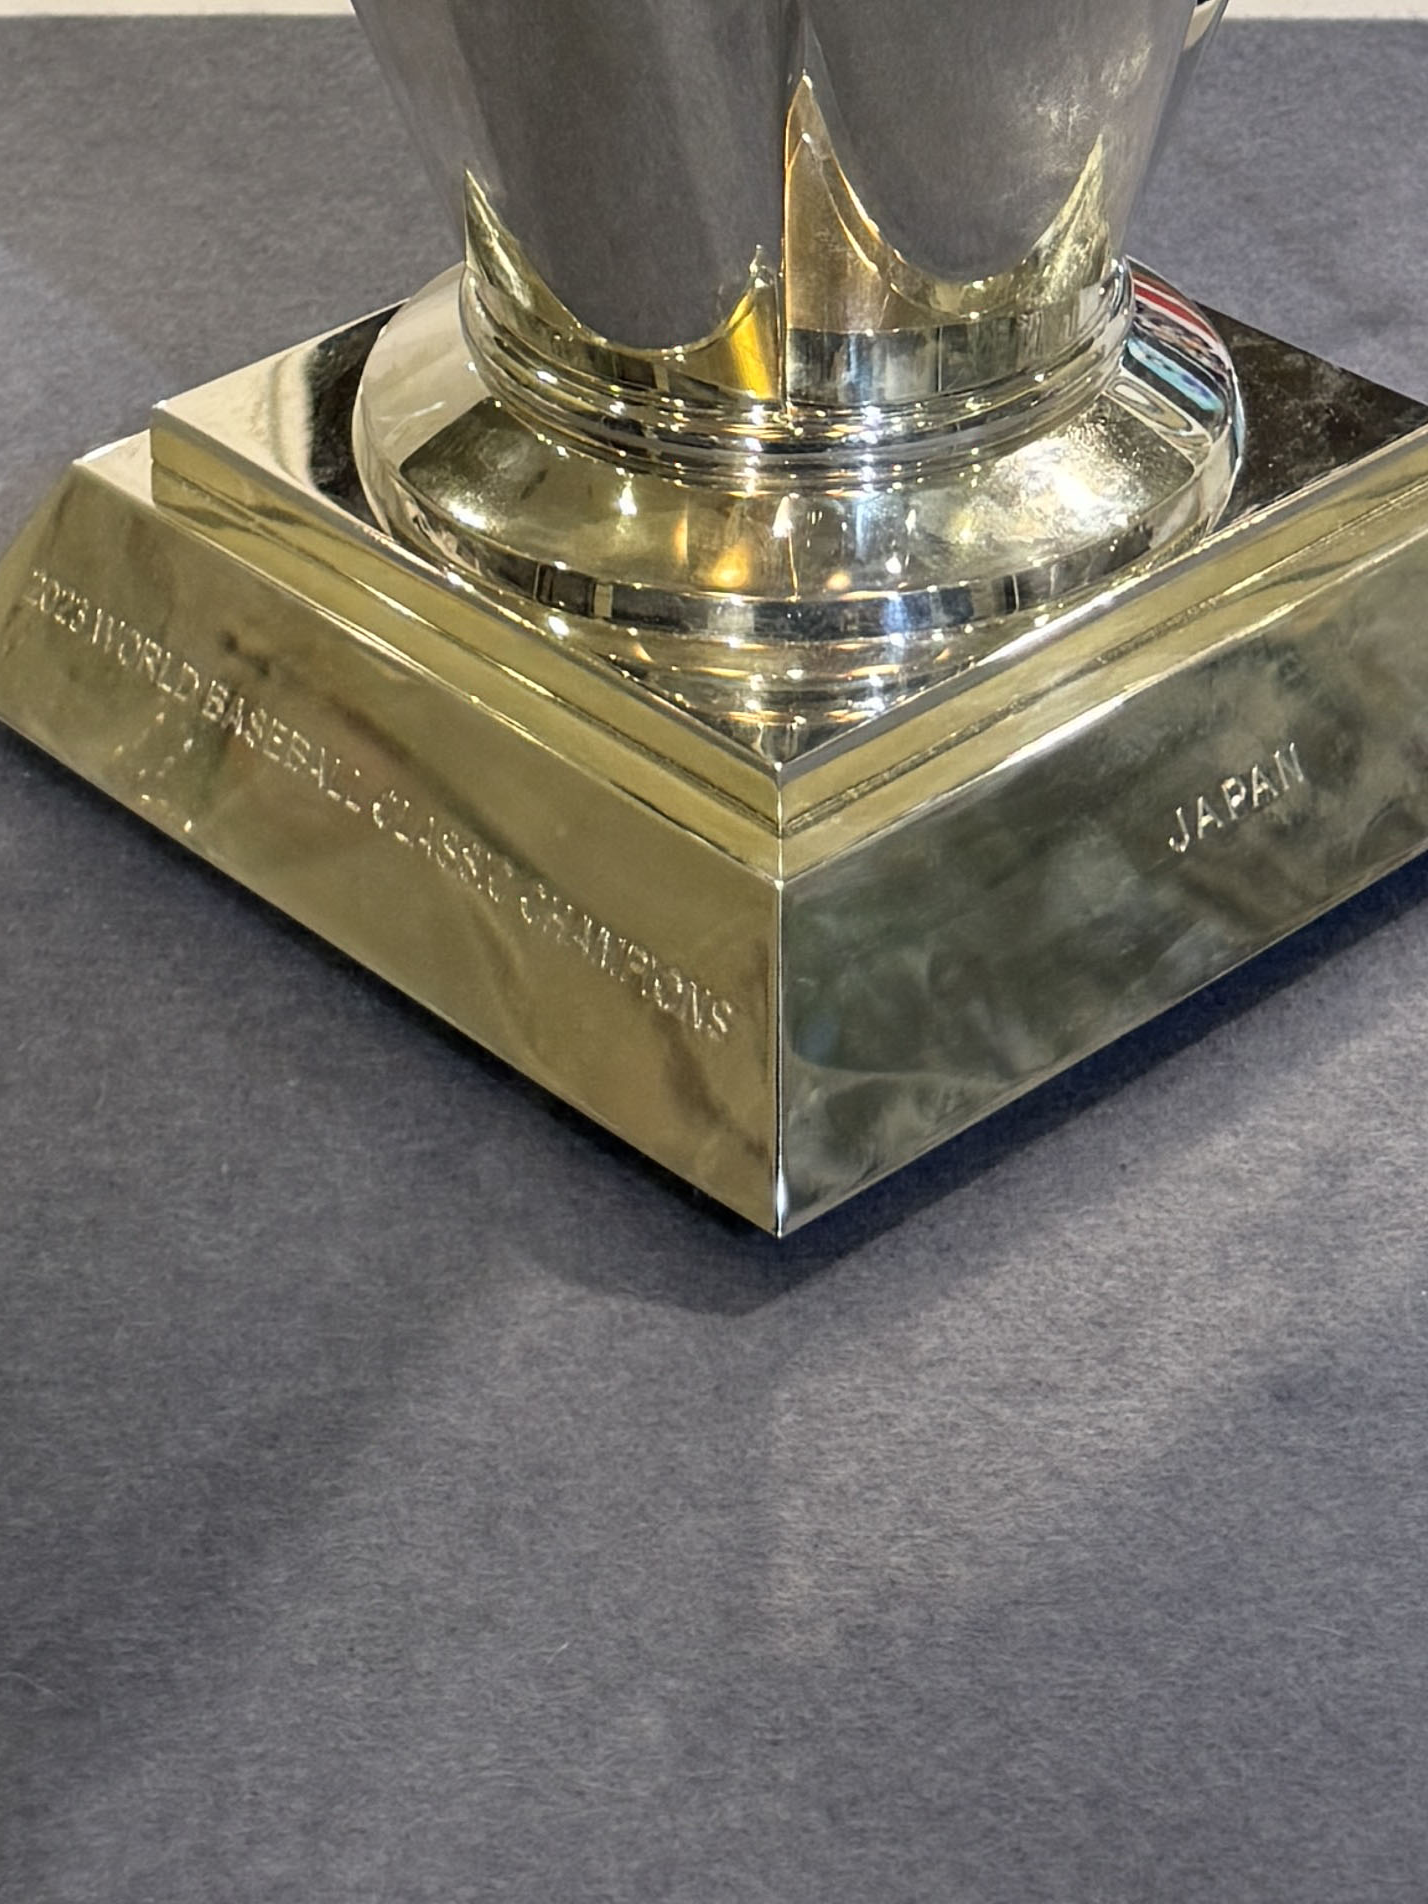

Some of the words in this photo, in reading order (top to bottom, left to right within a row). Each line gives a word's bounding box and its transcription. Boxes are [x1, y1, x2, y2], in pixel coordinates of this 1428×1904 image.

[91, 607, 201, 703] WORLD
[201, 679, 362, 813] BASEBALL
[371, 789, 514, 903] CLASSIC
[520, 882, 733, 1042] CHAMPIONS
[1168, 741, 1305, 854] JAPAN
